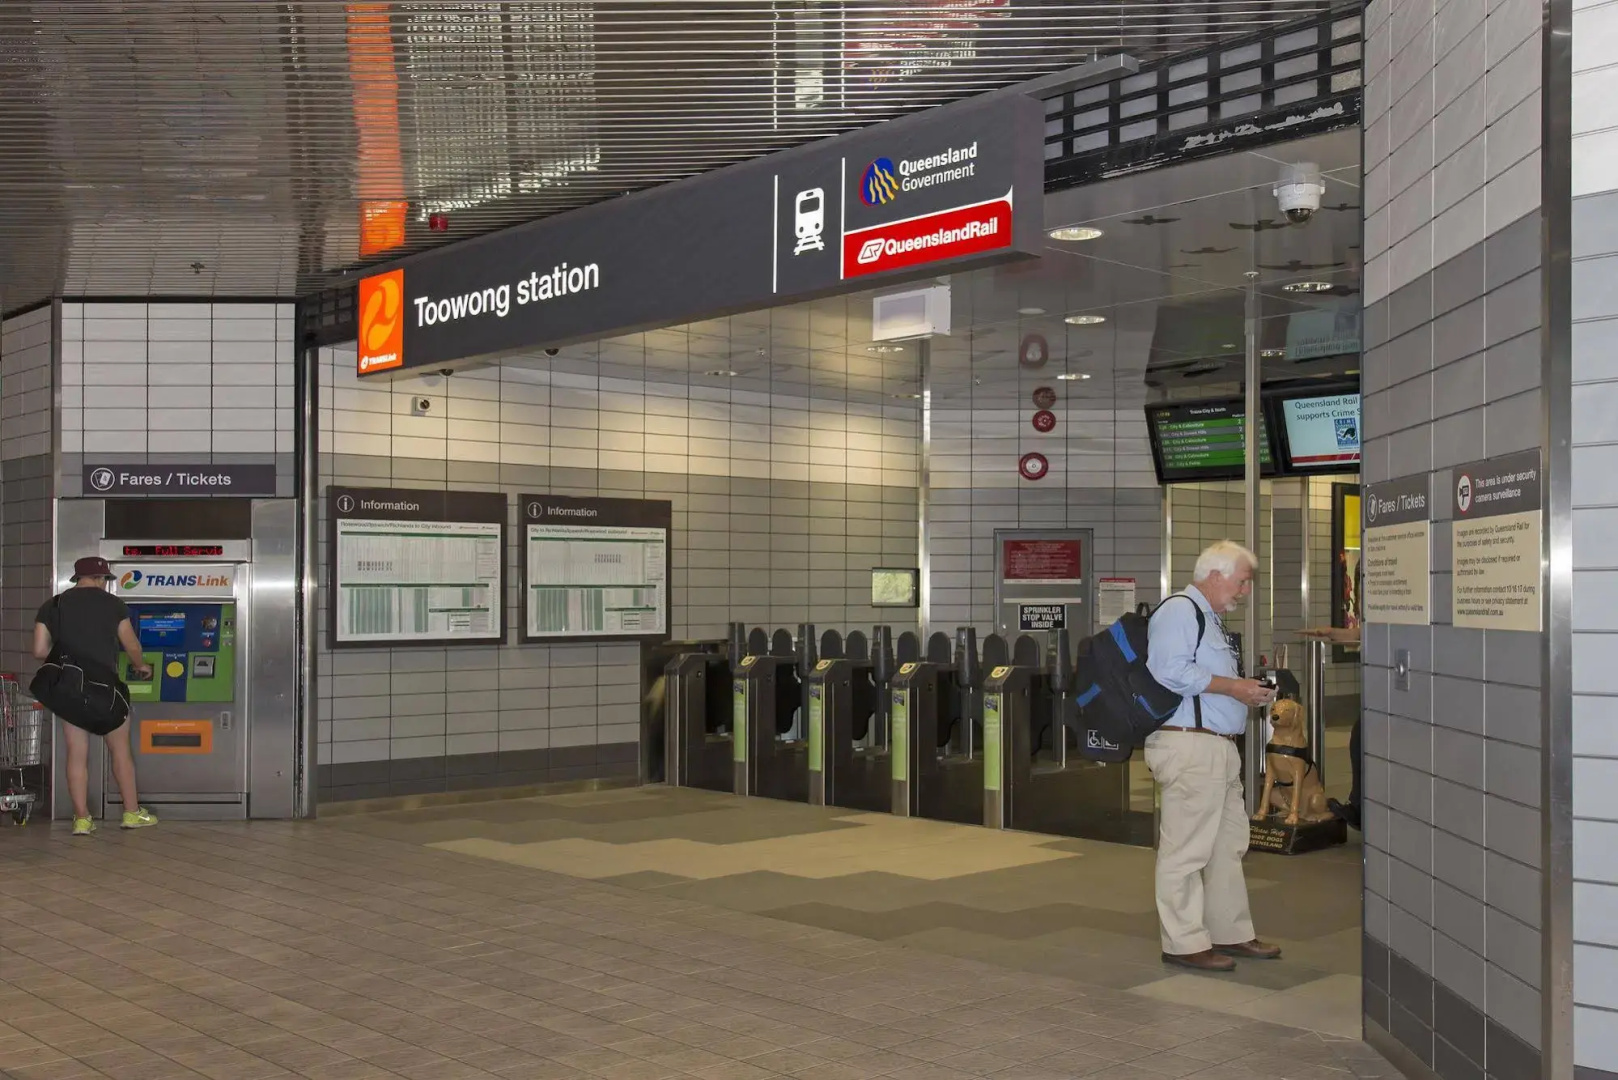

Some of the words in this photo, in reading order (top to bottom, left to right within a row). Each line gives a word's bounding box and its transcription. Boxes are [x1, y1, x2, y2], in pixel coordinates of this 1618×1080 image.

[899, 142, 977, 176] Queensland
[902, 162, 975, 191] Government
[885, 217, 998, 255] QueenslandRail
[414, 284, 510, 327] Toowong
[517, 262, 599, 305] station
[1295, 399, 1340, 410] Queensland
[1343, 397, 1358, 405] Rail
[1297, 411, 1330, 421] supports
[120, 473, 162, 486] Fares
[165, 473, 173, 486] /
[176, 473, 232, 486] Tickets
[1475, 478, 1485, 488] This
[1485, 478, 1496, 487] area
[1496, 474, 1501, 484] is
[1501, 473, 1516, 484] under
[1516, 469, 1537, 481] security
[1475, 493, 1492, 503] camera
[1493, 488, 1521, 500] surveillance
[360, 499, 420, 511] Information
[1378, 498, 1396, 514] Fares
[1396, 496, 1401, 512] /
[1401, 493, 1426, 510] Tickets
[547, 506, 597, 517] Information
[1495, 524, 1516, 533] Queensland
[155, 546, 179, 556] Full
[146, 575, 228, 587] TRANSLink
[1023, 606, 1061, 614] SPRINKLER
